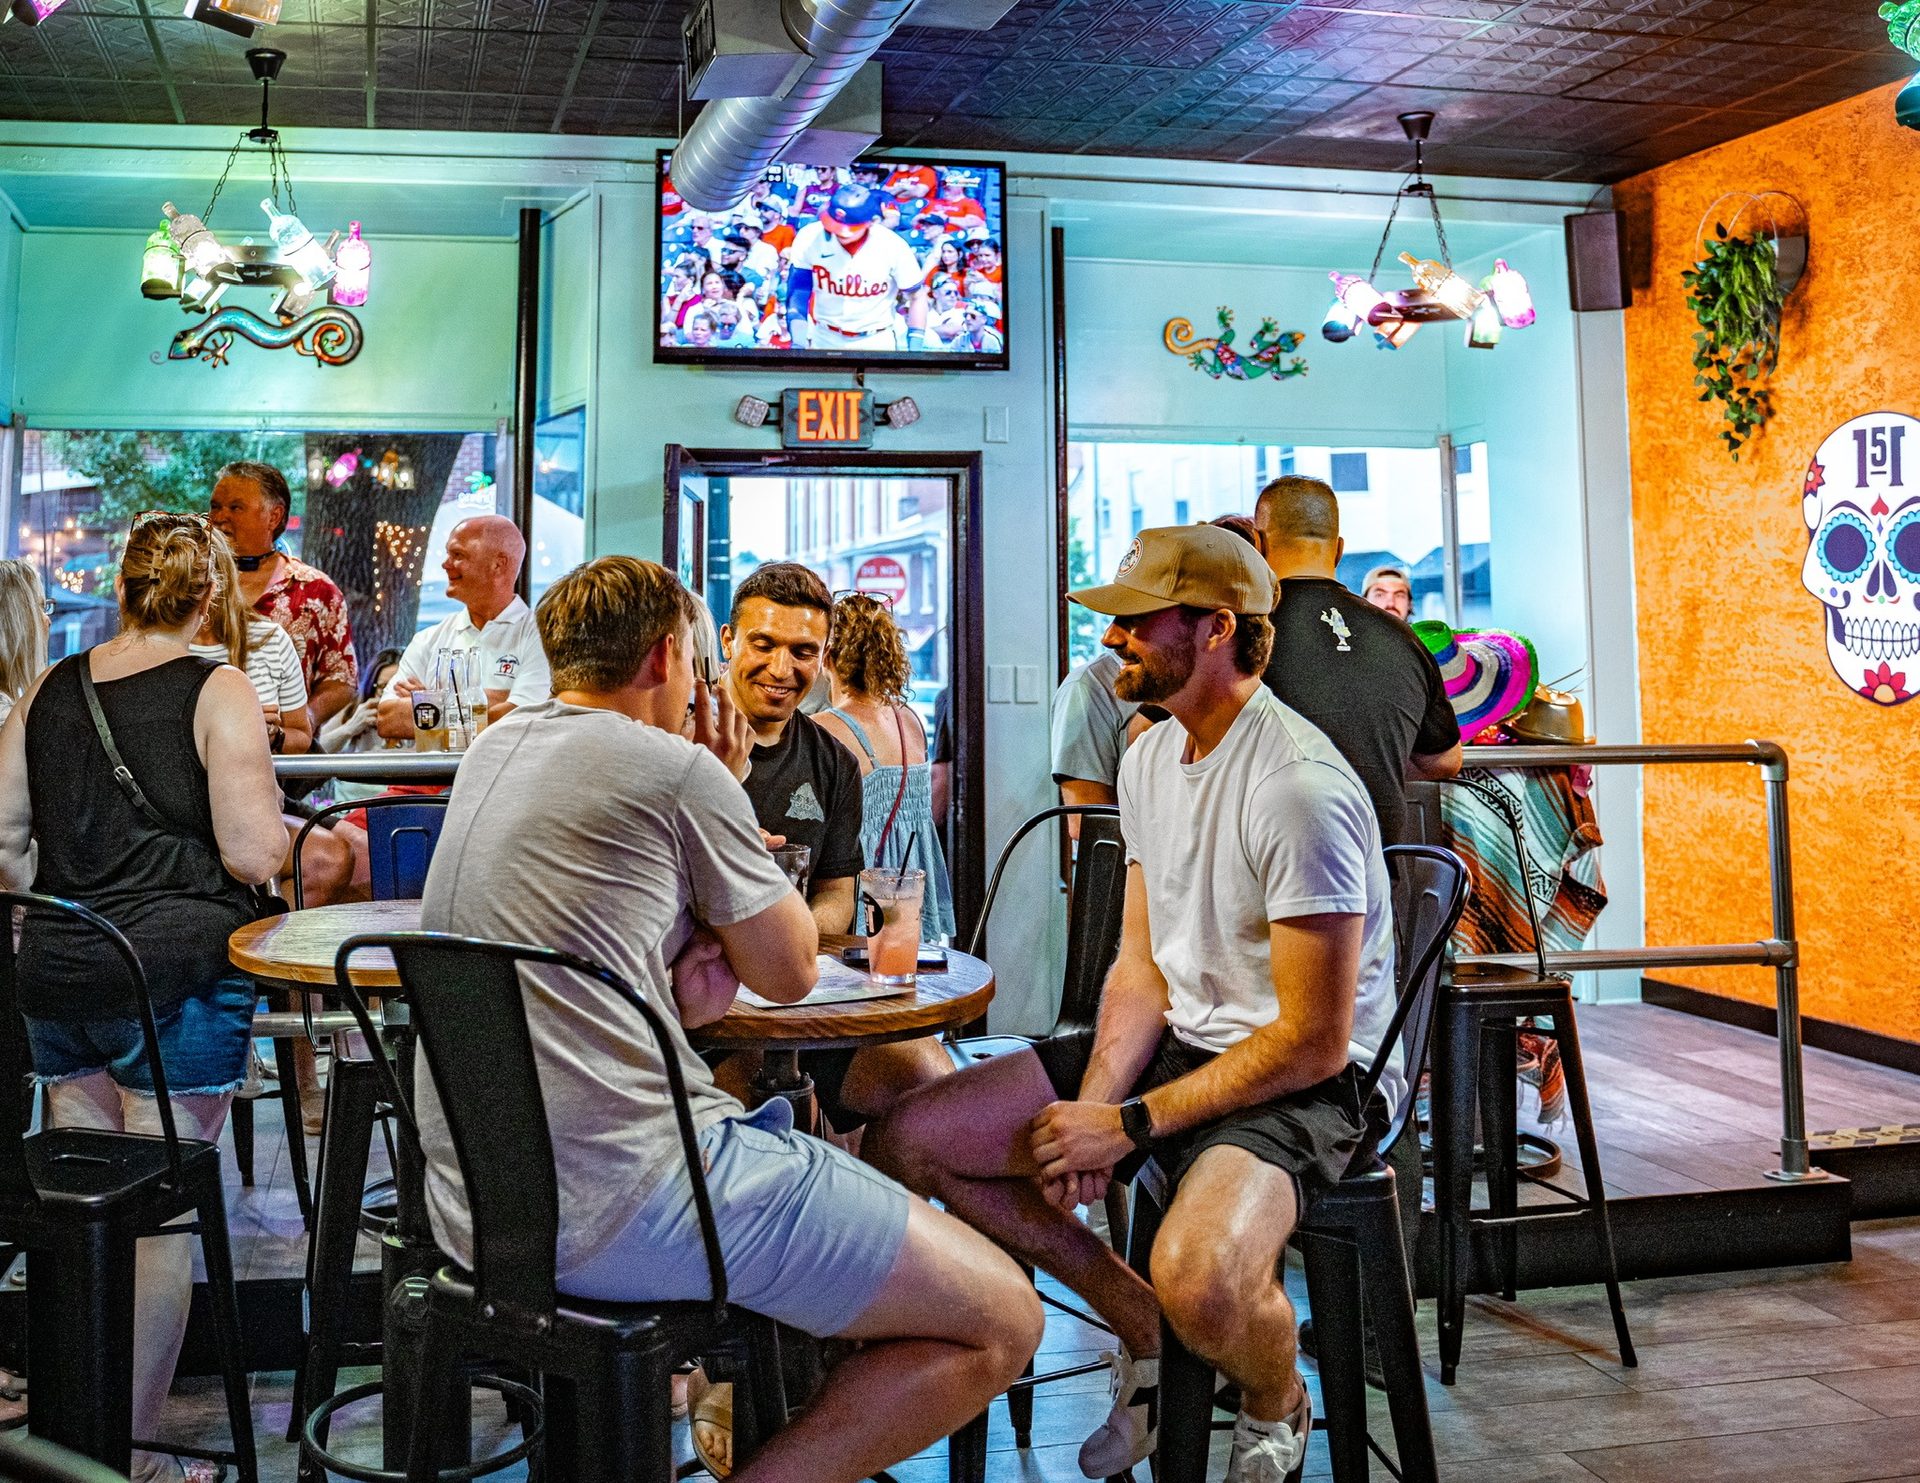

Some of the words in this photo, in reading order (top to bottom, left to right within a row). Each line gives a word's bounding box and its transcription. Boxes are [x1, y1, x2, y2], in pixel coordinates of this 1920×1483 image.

[812, 264, 888, 297] Phillies
[798, 390, 864, 440] EXIT
[861, 565, 876, 576] DO
[880, 565, 900, 576] NOT
